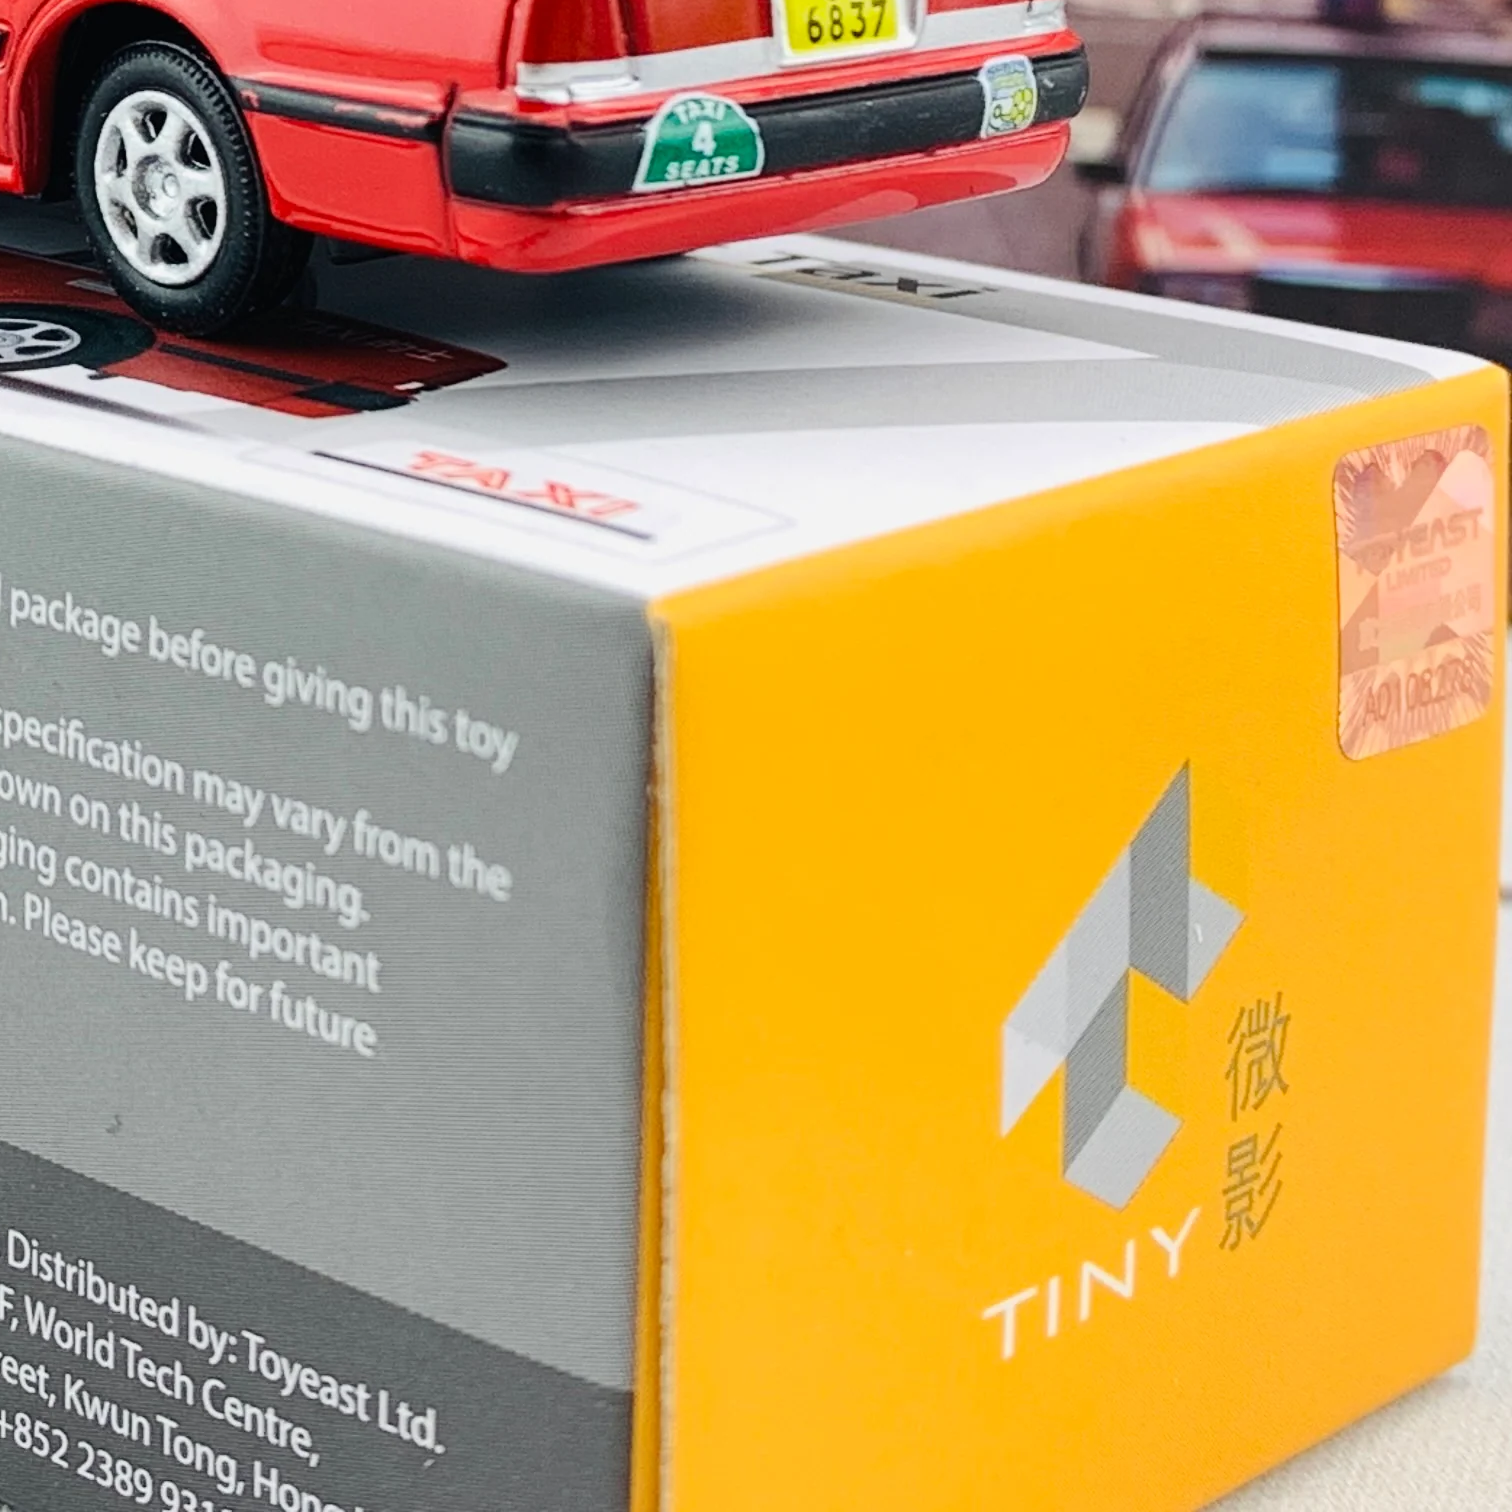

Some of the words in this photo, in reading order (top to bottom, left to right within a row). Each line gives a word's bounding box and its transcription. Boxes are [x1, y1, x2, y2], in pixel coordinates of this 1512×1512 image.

[807, 0, 887, 44] 6837
[665, 155, 740, 181] SEATS
[673, 99, 727, 124] TAXI
[692, 120, 717, 157] 4
[408, 449, 640, 517] TAXI
[9, 587, 141, 657] package
[149, 615, 257, 687] before
[262, 655, 374, 733] giving
[381, 684, 449, 744] this
[454, 707, 520, 775] toy
[69, 792, 111, 835] on
[118, 800, 178, 856] this
[185, 831, 371, 930] packaging.
[193, 767, 266, 828] may
[270, 791, 348, 856] vary
[352, 807, 440, 880] from
[447, 841, 514, 903] the
[23, 891, 121, 964] Please
[129, 927, 210, 1002] keep
[215, 959, 265, 1013] for
[270, 979, 379, 1057] future
[64, 854, 200, 929] contains
[207, 893, 384, 995] important
[1218, 990, 1292, 1253] 微影
[7, 1228, 180, 1337] Distributed
[188, 1304, 238, 1365] by:
[240, 1329, 373, 1422] Toyeast
[378, 1389, 447, 1454] Ltd.
[981, 1206, 1202, 1362] TINY
[24, 1294, 115, 1369] World
[119, 1337, 194, 1405] Tech
[201, 1378, 320, 1468] Centre,
[64, 1373, 152, 1446] Kwun
[156, 1414, 245, 1496] Tong,
[254, 1460, 345, 1512] Hon
[77, 1441, 153, 1504] 2389
[160, 1481, 233, 1512] 93
